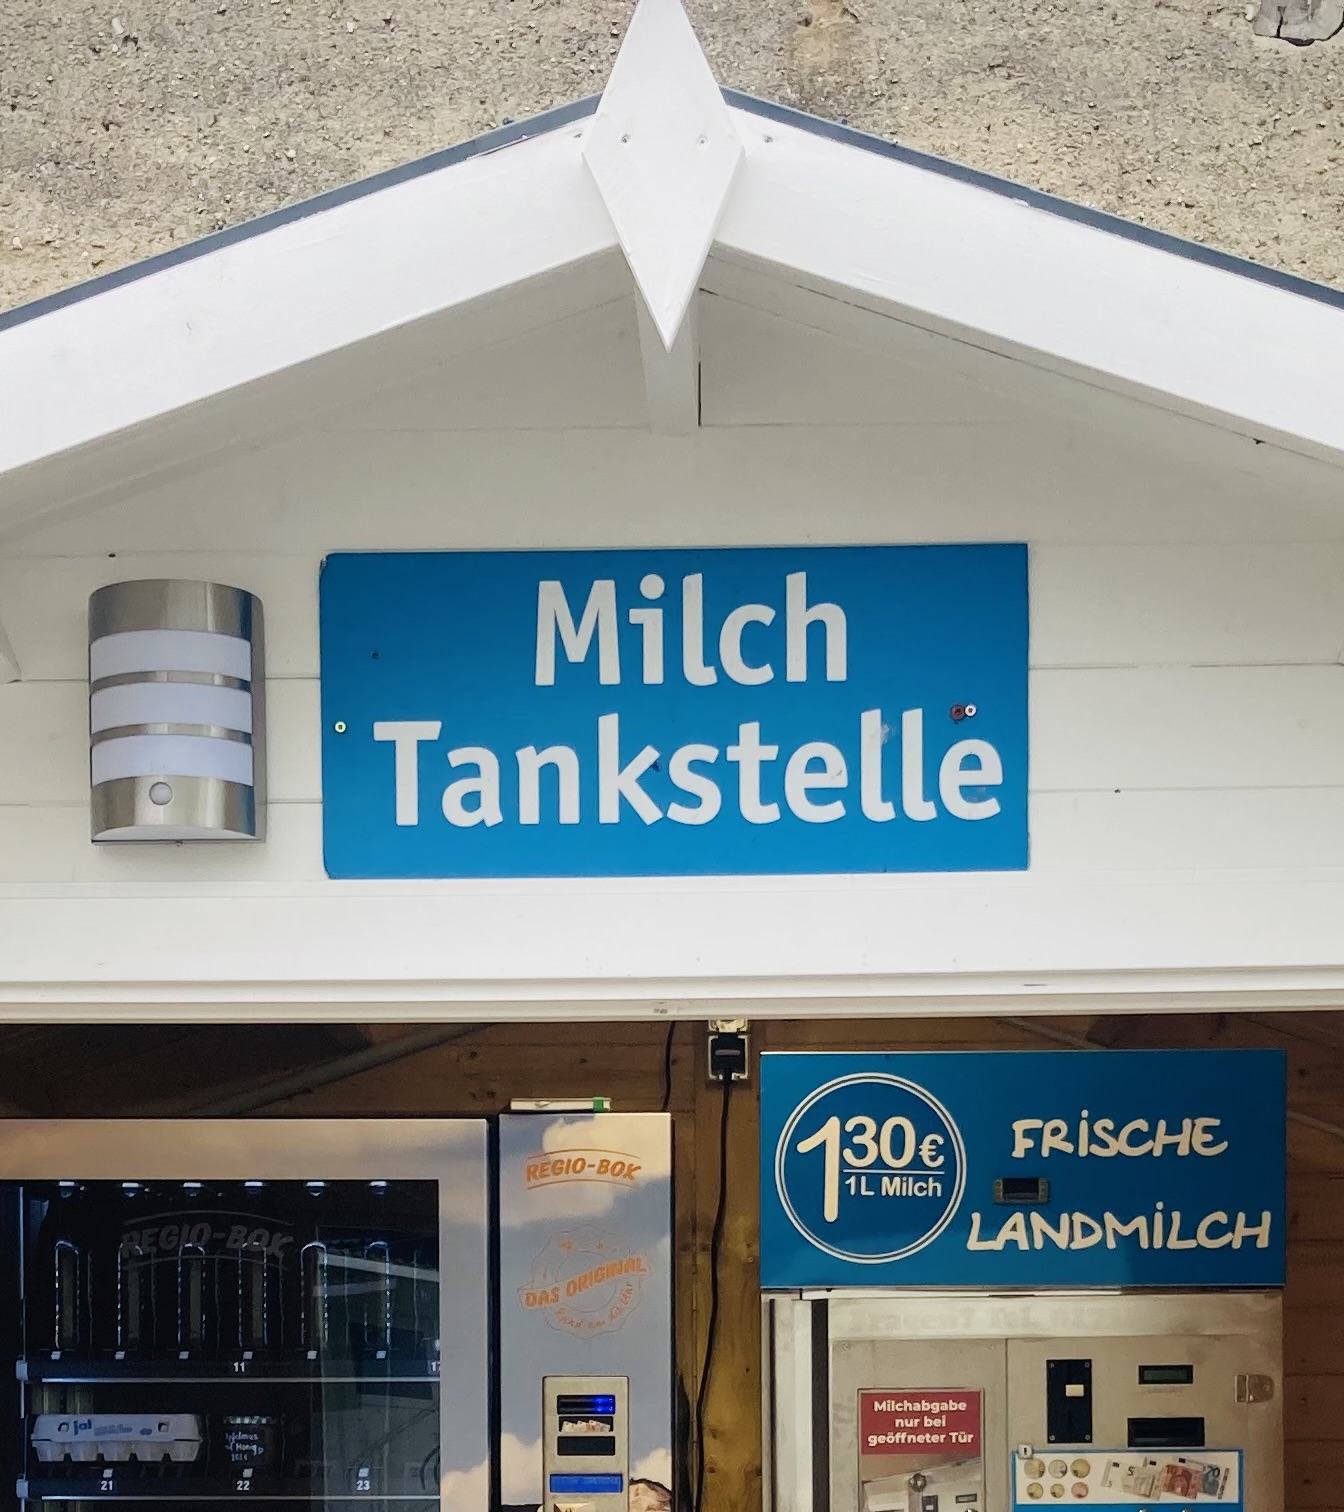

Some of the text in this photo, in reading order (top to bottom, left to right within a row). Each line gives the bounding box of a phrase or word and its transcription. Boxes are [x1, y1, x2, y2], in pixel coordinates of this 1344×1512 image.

[533, 571, 847, 687] Milch
[373, 708, 1004, 829] Tankstelle
[881, 1176, 942, 1197] Milch
[525, 1257, 647, 1307] DAS ORIGINAL
[233, 1362, 246, 1372] 11
[873, 1399, 967, 1414] Milchabgabe
[894, 1415, 946, 1427] nur bei
[868, 1432, 974, 1446] geöffneter Tür
[100, 1481, 113, 1491] 21
[236, 1480, 250, 1491] 22
[356, 1480, 370, 1491] 23
